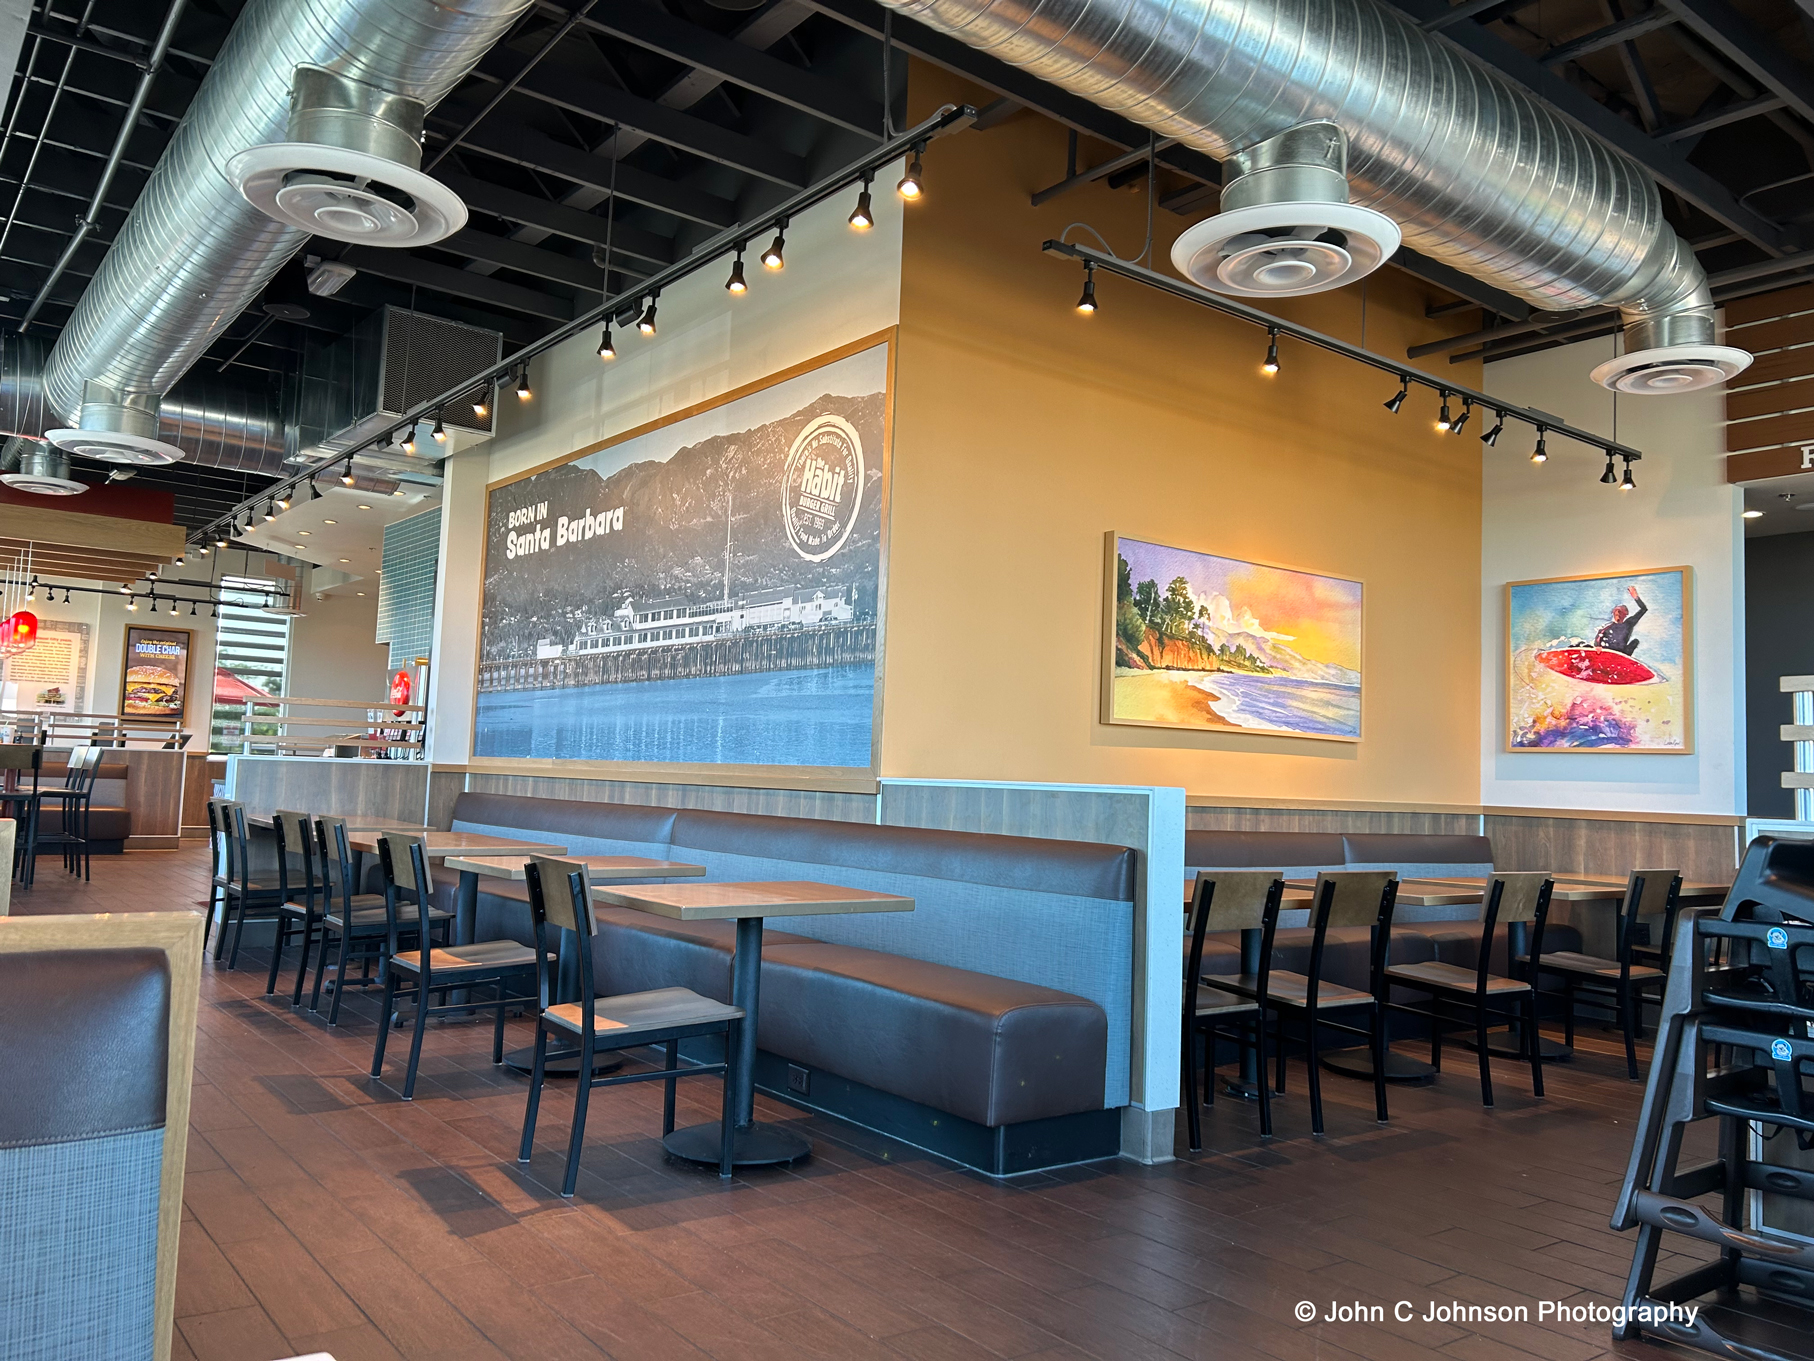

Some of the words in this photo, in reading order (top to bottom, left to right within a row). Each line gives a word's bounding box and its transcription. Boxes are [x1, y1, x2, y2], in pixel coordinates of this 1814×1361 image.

[797, 445, 812, 468] There's
[819, 434, 842, 449] Substitute
[840, 443, 849, 457] For
[845, 455, 855, 483] Quality
[508, 505, 535, 529] BORN
[536, 501, 548, 521] IN
[799, 496, 821, 511] BURGER
[820, 503, 836, 516] GRILL
[506, 524, 551, 560] Santa
[556, 506, 624, 546] Barbara
[791, 507, 800, 532] Quality
[798, 528, 809, 543] Food
[808, 534, 821, 546] Made
[827, 520, 840, 538] Order
[135, 643, 162, 654] DOUBLE
[162, 645, 181, 656] CHAR
